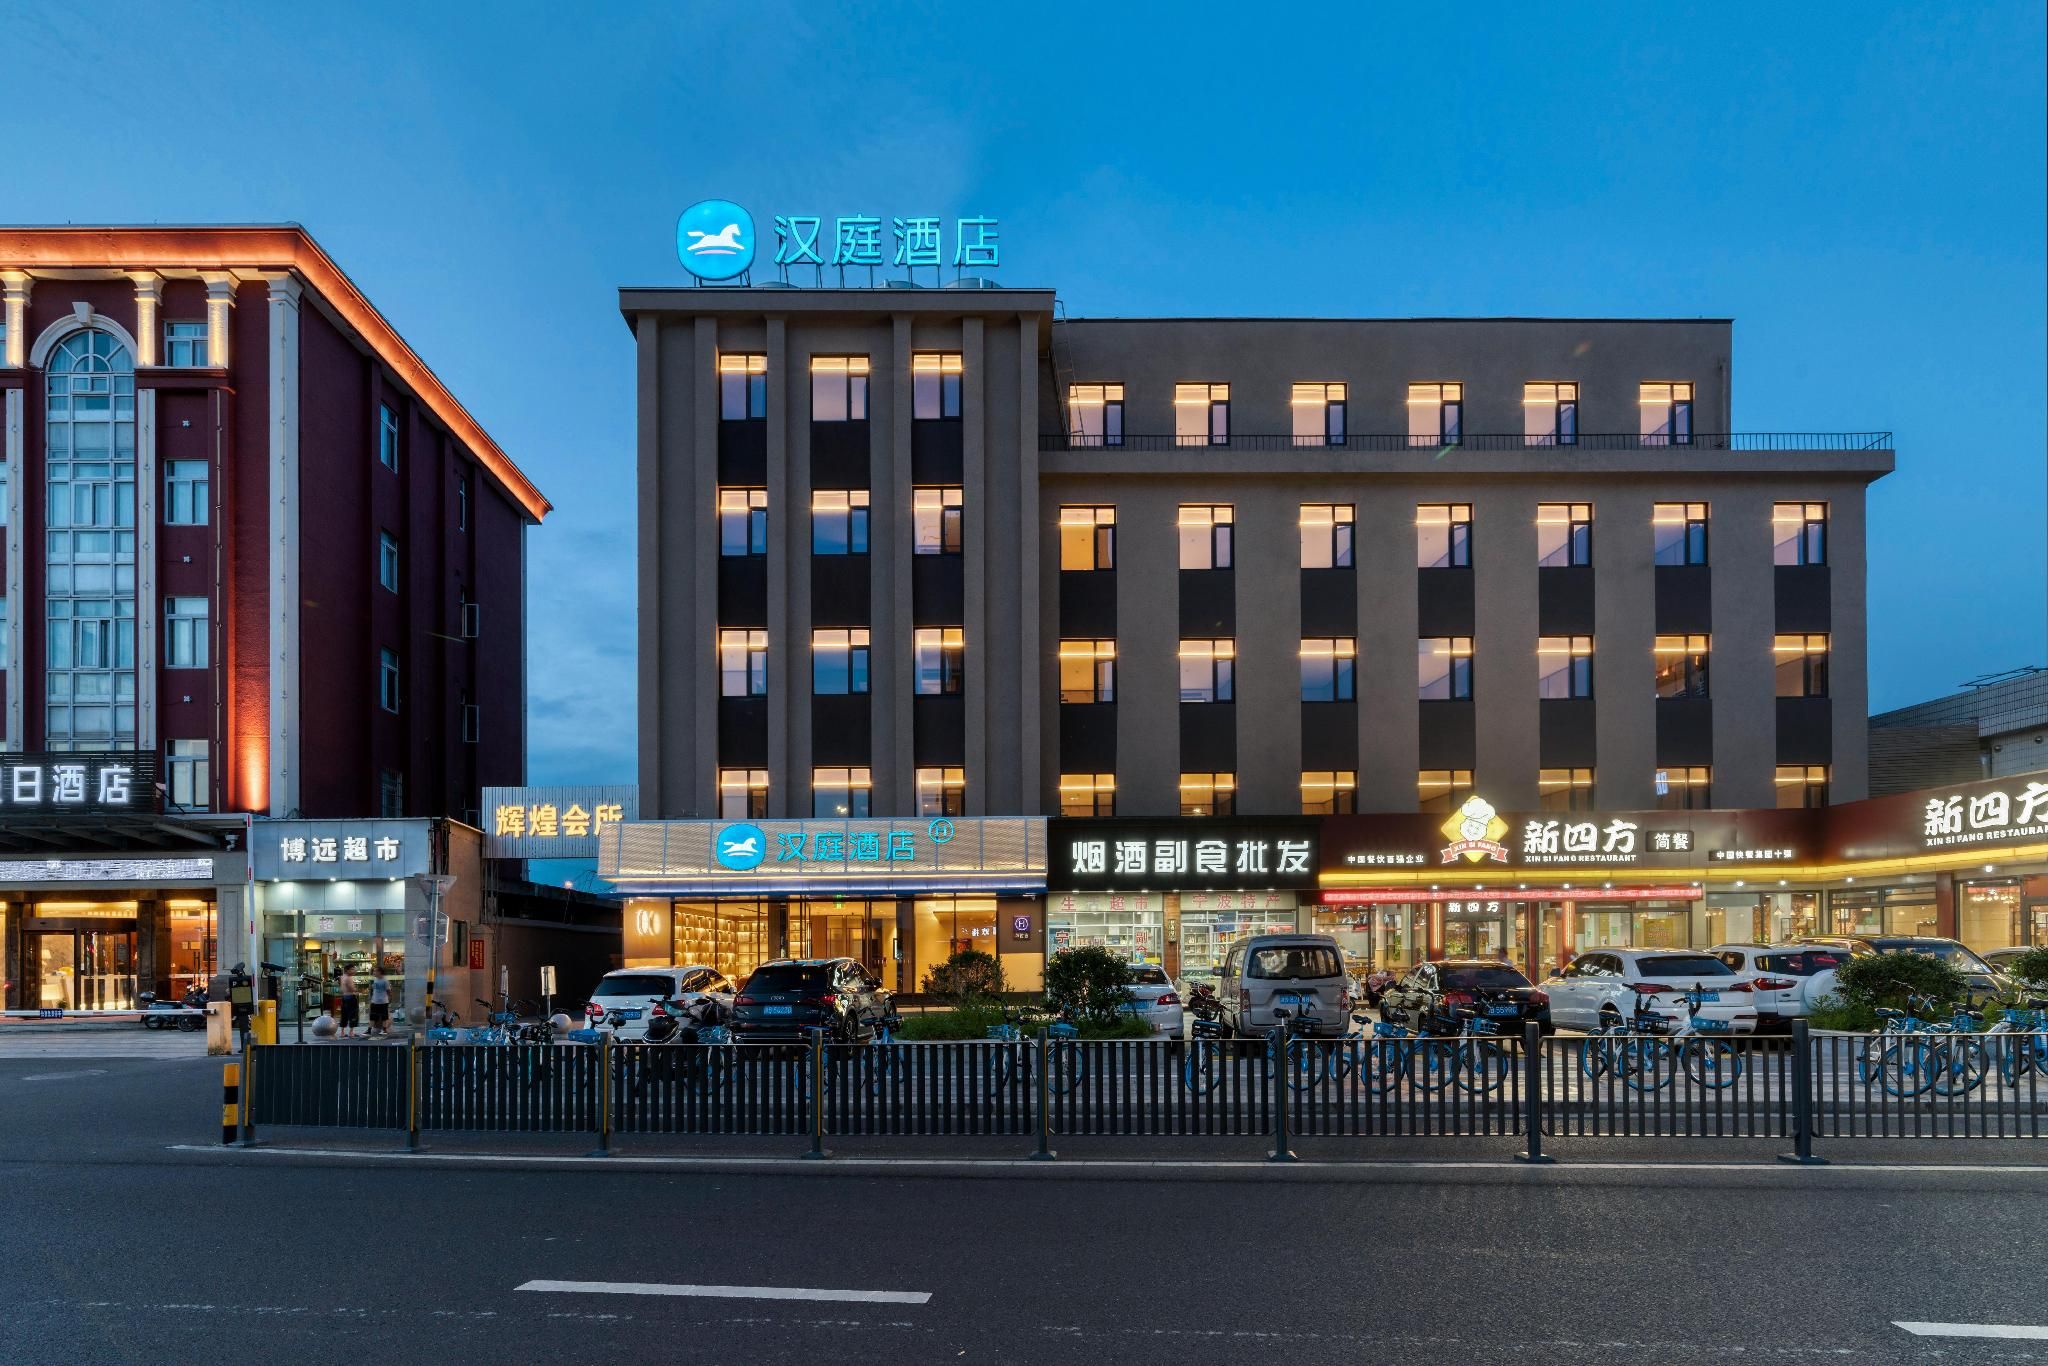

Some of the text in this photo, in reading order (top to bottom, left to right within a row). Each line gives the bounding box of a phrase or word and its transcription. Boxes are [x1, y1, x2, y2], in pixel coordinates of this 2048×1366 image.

[774, 213, 999, 266] 汉庭酒店
[0, 764, 131, 803] 日酒店
[1924, 782, 2048, 836] 新四方
[1523, 819, 1638, 853] 新四方
[1654, 833, 1690, 850] 简餐
[1926, 838, 1943, 846] XIN
[281, 836, 400, 862] 博远超市
[777, 831, 915, 862] 汉庭酒店
[1716, 849, 1793, 860] 中国快餐集团十强
[1072, 841, 1310, 873] 烟酒副食批发
[1347, 854, 1424, 864] 中国餐饮百强企业
[1525, 855, 1541, 863] XIN
[1578, 854, 1637, 862] RESTAURANT
[1192, 894, 1281, 910] 宁波特产
[1448, 902, 1500, 913] 新四方
[320, 917, 363, 932] 超市
